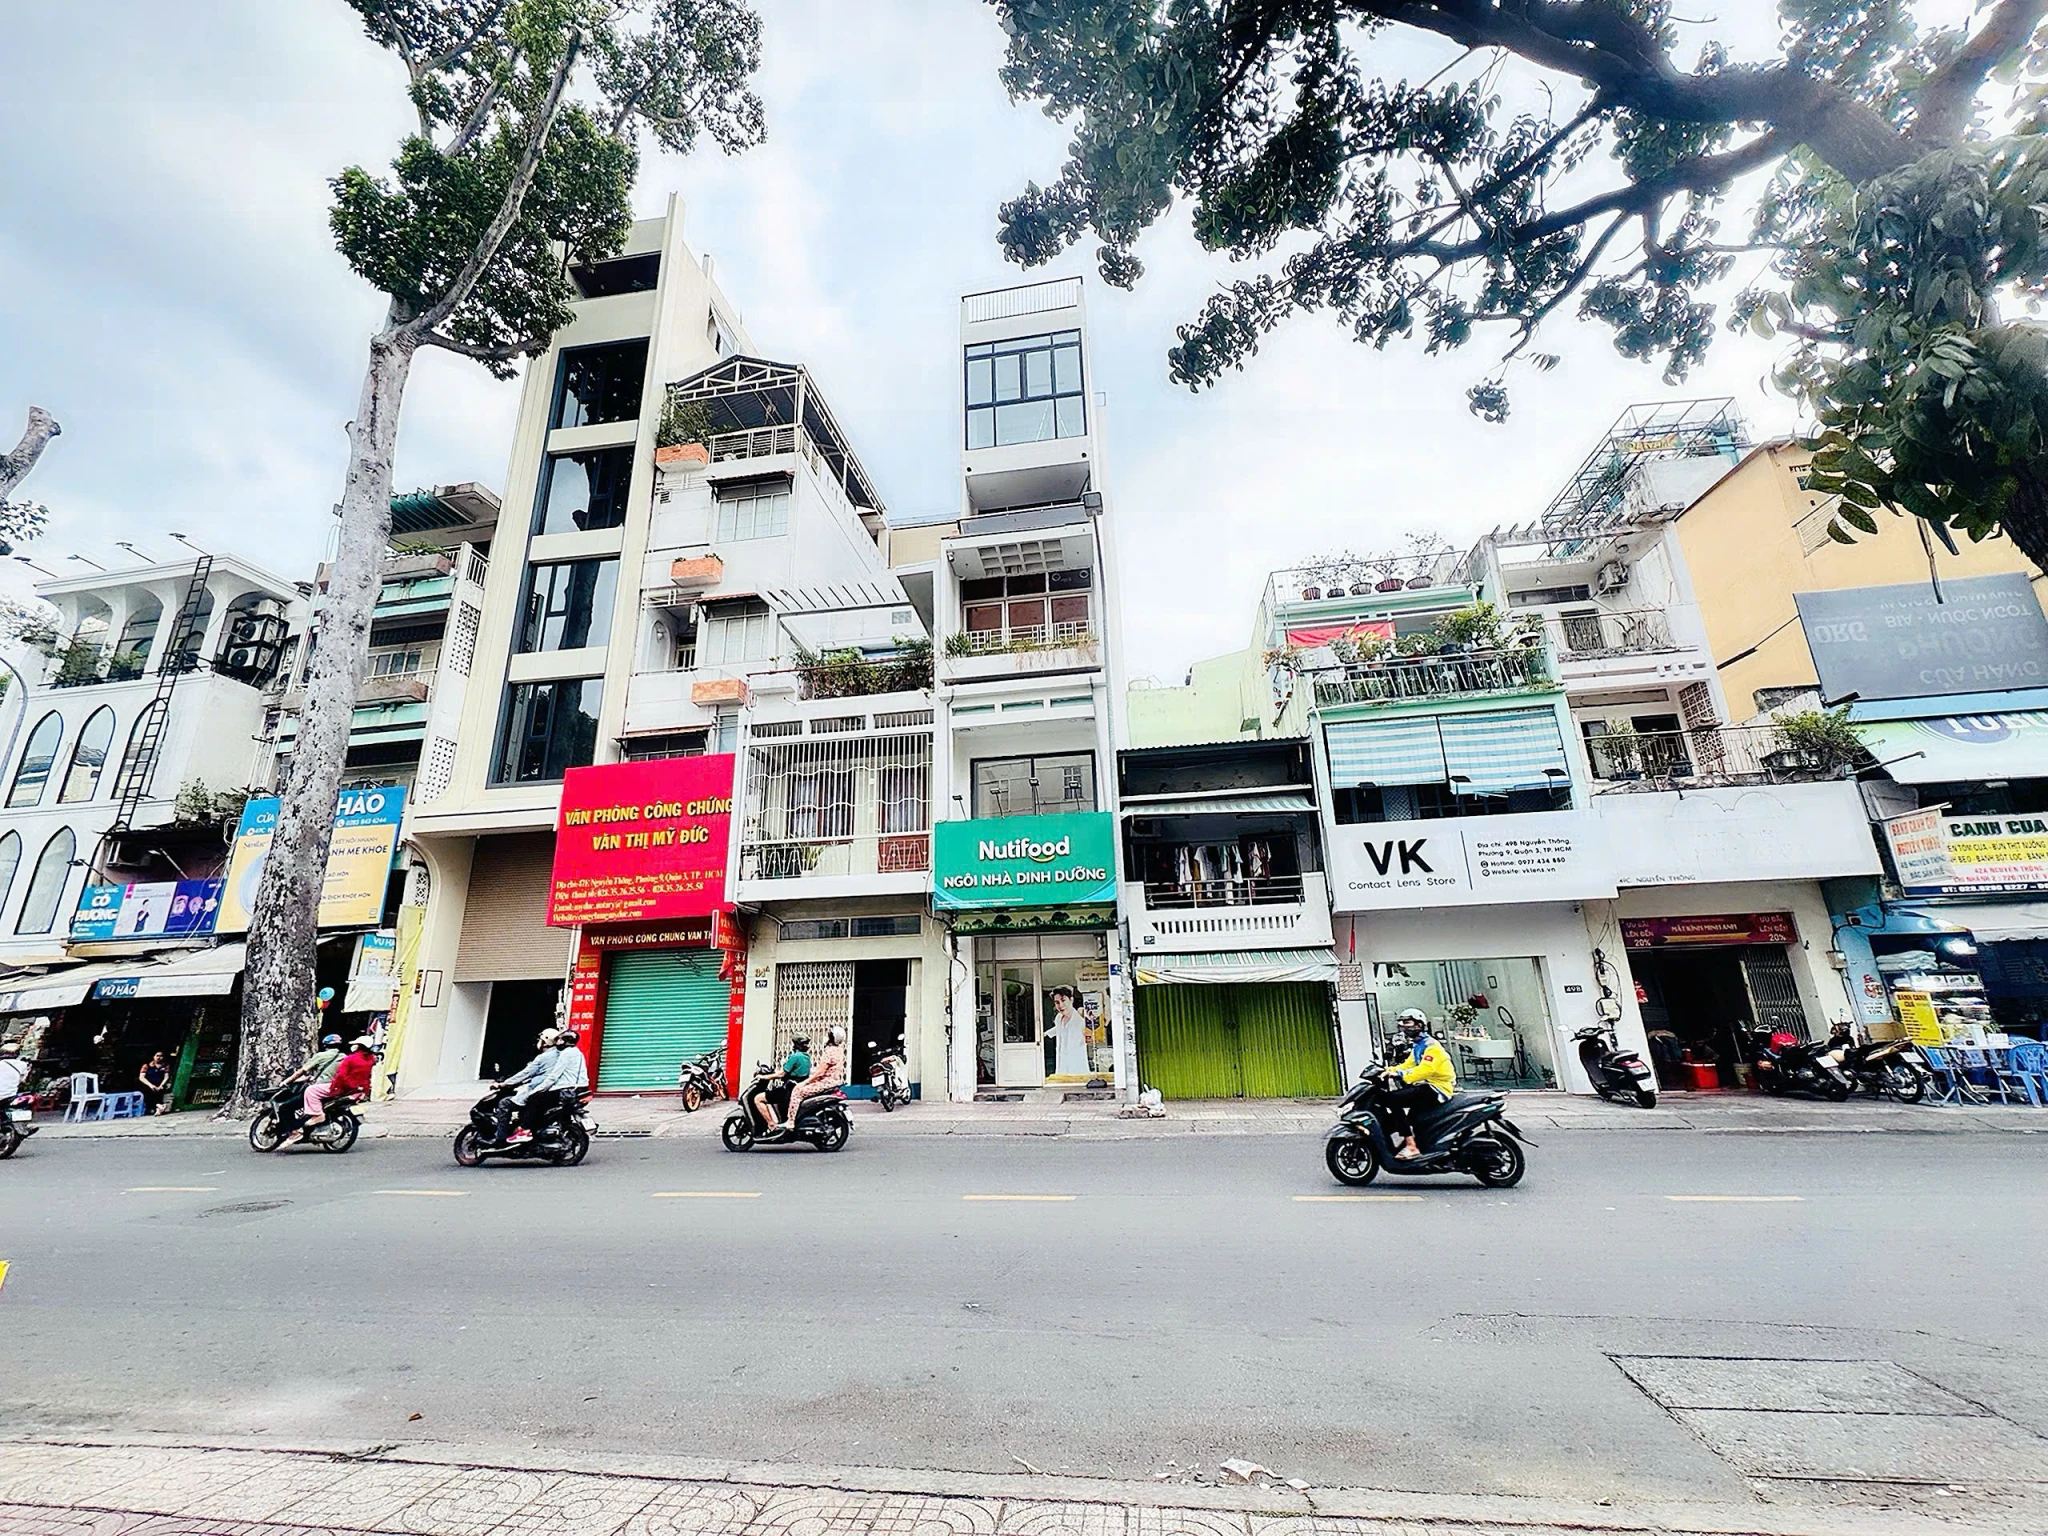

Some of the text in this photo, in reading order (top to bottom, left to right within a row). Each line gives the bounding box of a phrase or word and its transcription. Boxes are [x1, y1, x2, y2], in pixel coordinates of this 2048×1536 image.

[565, 809, 591, 826] VĂN
[593, 805, 640, 823] PHÒNG
[644, 801, 682, 819] CÔNG
[592, 825, 709, 850] VĂN THỊ MỸ ĐỨC
[1950, 819, 2048, 837] CANH CUA
[979, 835, 1070, 861] Nutifood
[1363, 838, 1434, 876] VK
[943, 866, 1107, 889] NGÔI NHÀ DINH DƯỠNG
[1348, 876, 1456, 890] Contact Lens Store
[1634, 939, 1651, 947] 20%
[1769, 933, 1787, 942] 20%
[1383, 979, 1401, 988] Lens
[1404, 979, 1426, 987] Store
